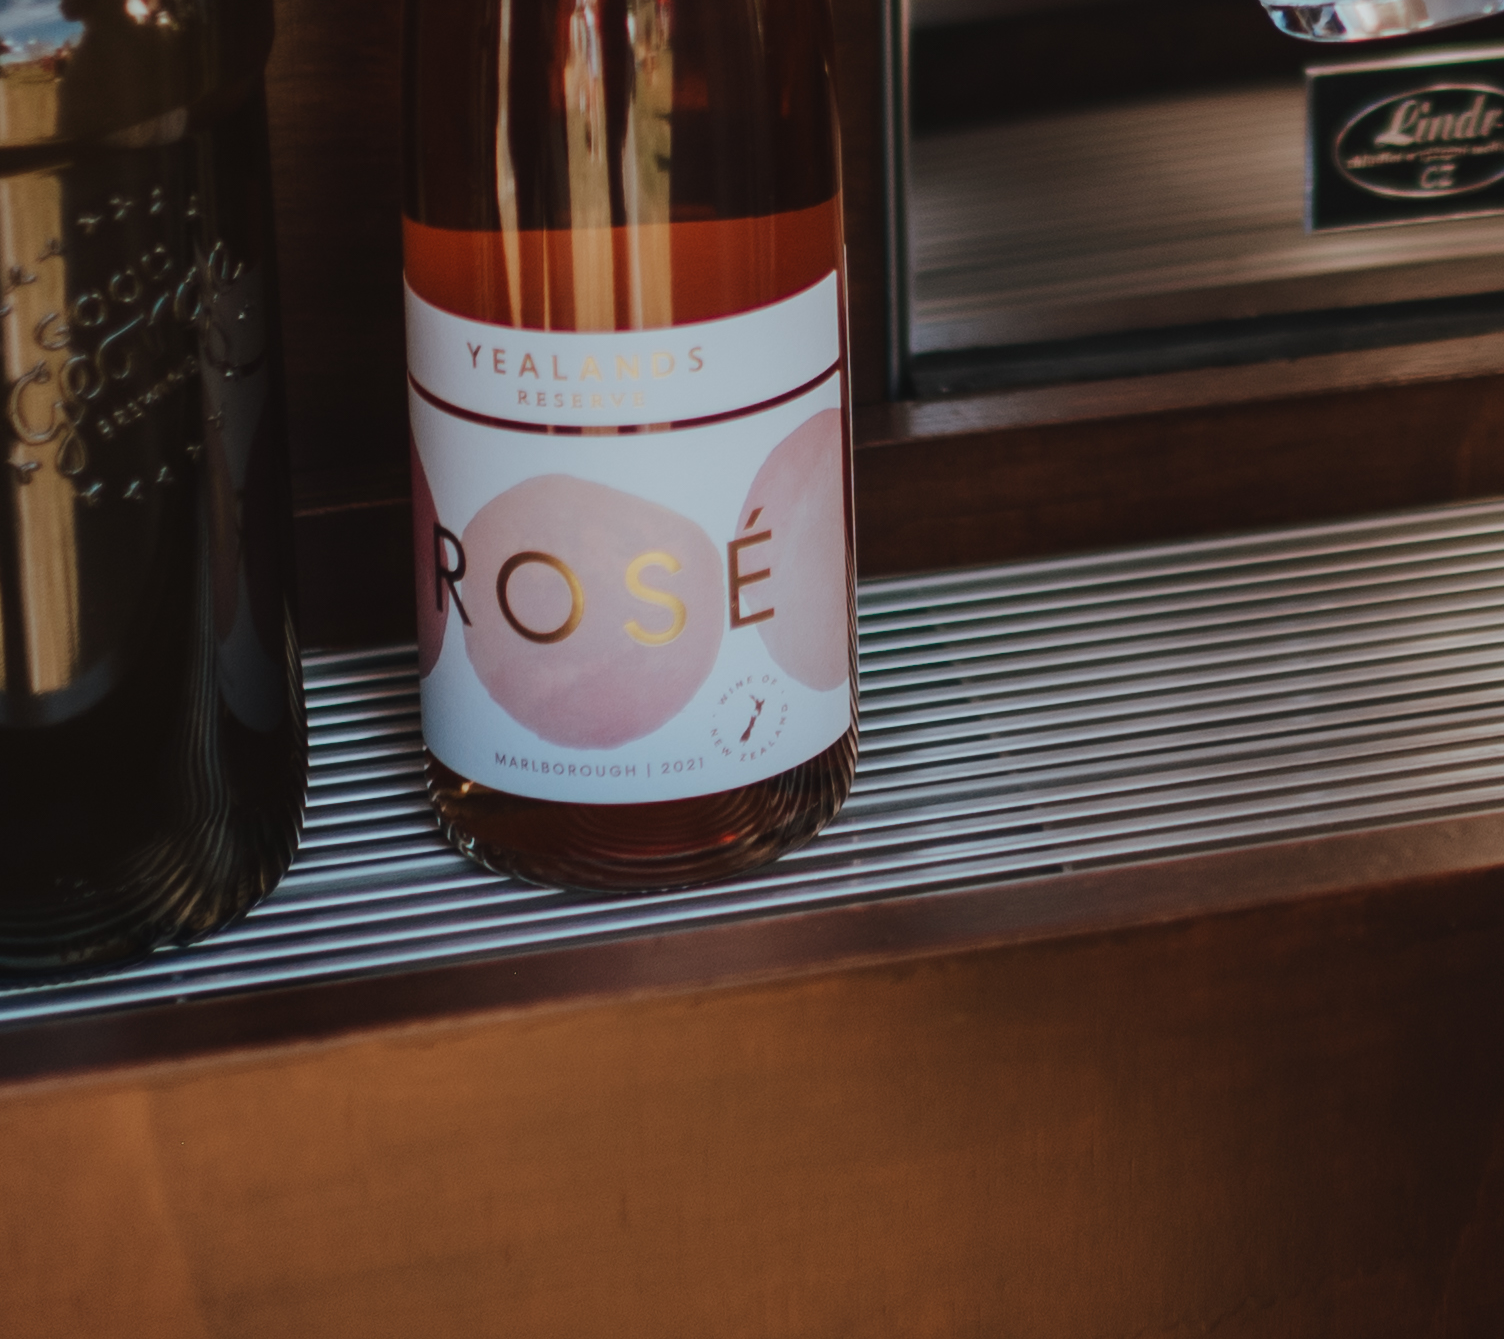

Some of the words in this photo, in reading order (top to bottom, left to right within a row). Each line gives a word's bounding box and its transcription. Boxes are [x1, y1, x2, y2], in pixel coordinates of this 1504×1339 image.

[1372, 94, 1504, 147] Lindr
[466, 341, 705, 381] YEALANDS
[516, 389, 645, 409] RESERVE
[433, 506, 777, 648] ROSÉ
[494, 751, 637, 778] MARLBOROUGH
[660, 756, 705, 775] 2021
